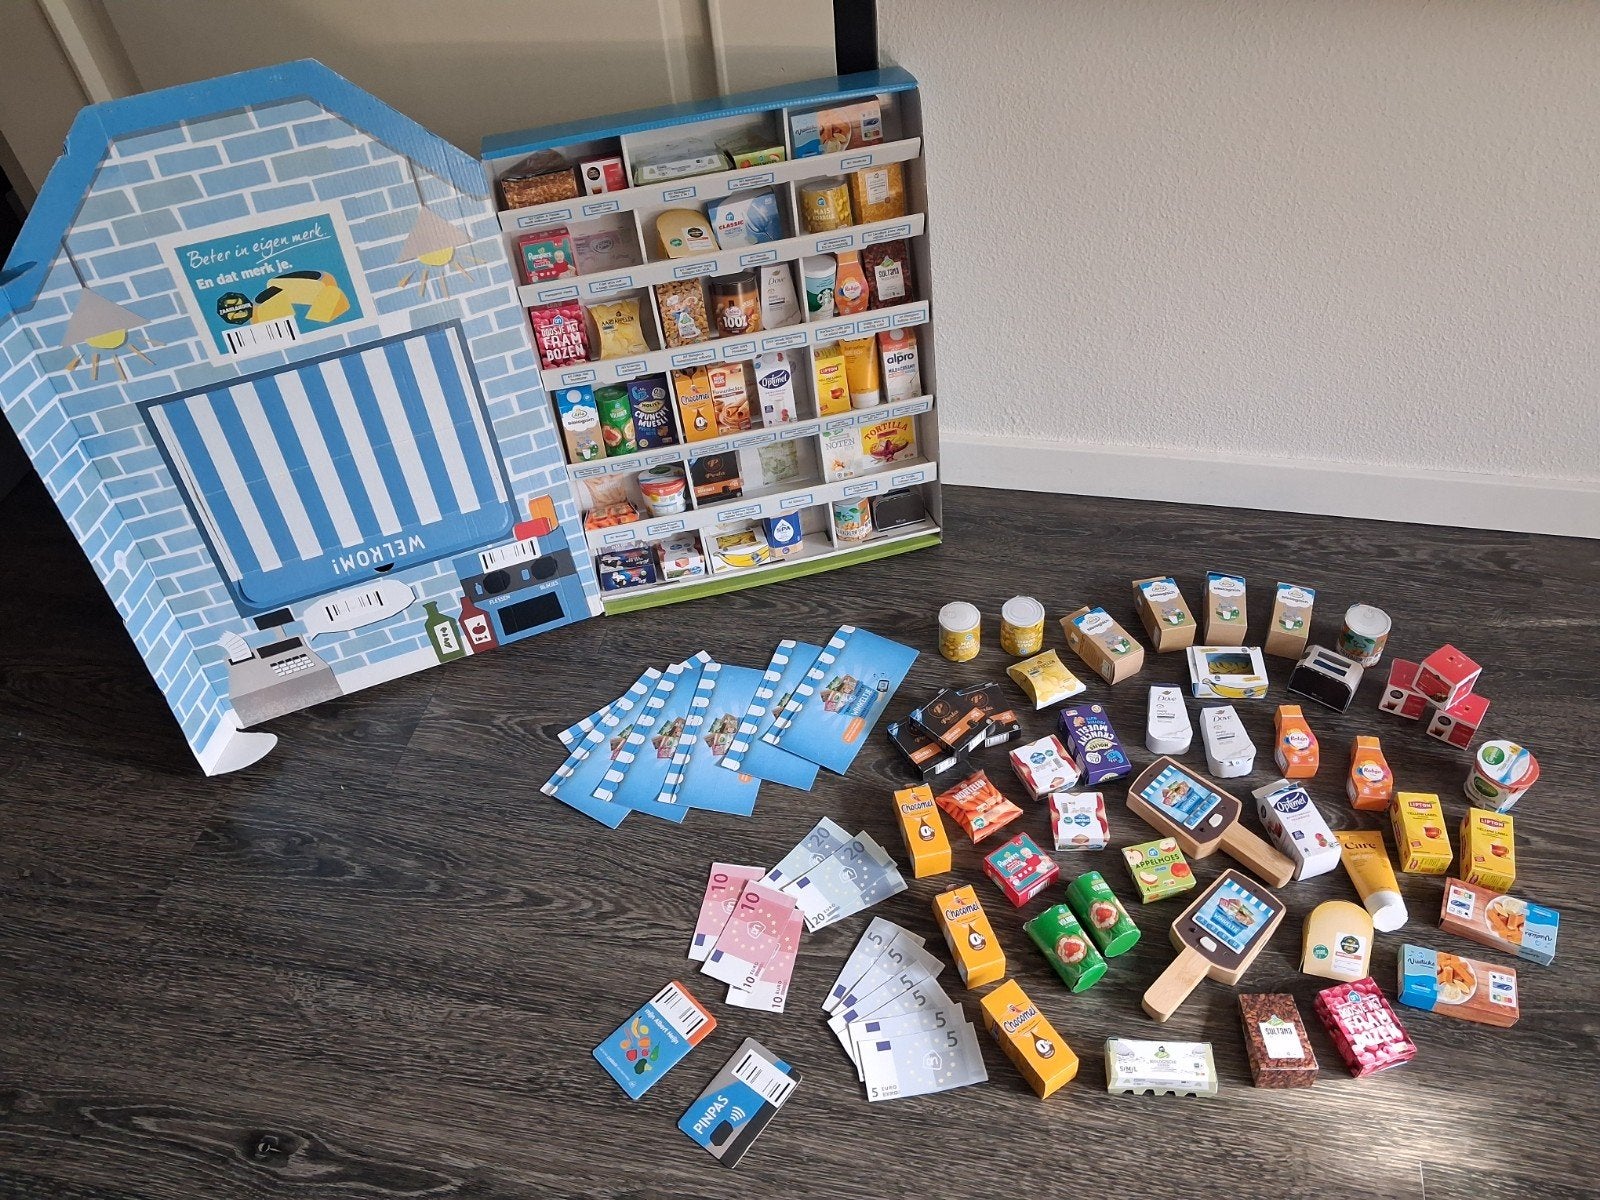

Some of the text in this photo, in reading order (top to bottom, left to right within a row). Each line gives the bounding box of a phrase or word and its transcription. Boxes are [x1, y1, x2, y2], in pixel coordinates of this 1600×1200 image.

[719, 220, 744, 230] CLASSIC
[187, 223, 327, 268] Beter in eigen merk.
[196, 259, 293, 290] En dat merk je.
[542, 332, 582, 349] FRAM
[546, 344, 586, 361] BOZEN
[887, 353, 914, 364] alpro
[762, 374, 787, 387] Optimel
[680, 392, 710, 405] Chocomel
[634, 405, 670, 420] CRUNCHY
[638, 417, 668, 428] MUESLI
[864, 420, 908, 441] TORTILLA
[825, 438, 855, 450] NOTEN
[777, 525, 791, 533] SPA
[331, 534, 425, 575] WELKOM!
[488, 594, 512, 605] FLESSEN
[1075, 724, 1108, 737] MUESLI
[1078, 730, 1115, 746] CRUNCHY
[901, 799, 934, 814] Chocomel
[1276, 794, 1307, 812] Optimel
[1480, 818, 1505, 827] LIPTON
[814, 826, 831, 847] 20
[849, 840, 866, 861] 20
[1344, 842, 1376, 850] Care
[1135, 853, 1180, 869] APPELMOES
[712, 873, 728, 891] 10
[741, 892, 760, 911] 10
[812, 903, 836, 926] 20 EURO
[946, 902, 979, 921] Chocomel
[867, 932, 883, 945] 5
[887, 948, 903, 964] 5
[743, 976, 755, 988] 10
[900, 974, 914, 990] 5
[772, 996, 783, 1008] 10
[912, 990, 926, 1006] 5
[935, 1011, 946, 1028] 5
[1003, 1006, 1036, 1033] Chocomel
[1343, 1008, 1394, 1034] FRAM
[653, 1018, 669, 1036] Albert
[665, 1031, 679, 1045] Heijn
[946, 1030, 958, 1047] 5
[1352, 1023, 1404, 1047] BOZEN
[872, 1087, 879, 1098] 5
[693, 1095, 729, 1134] PINPAS
